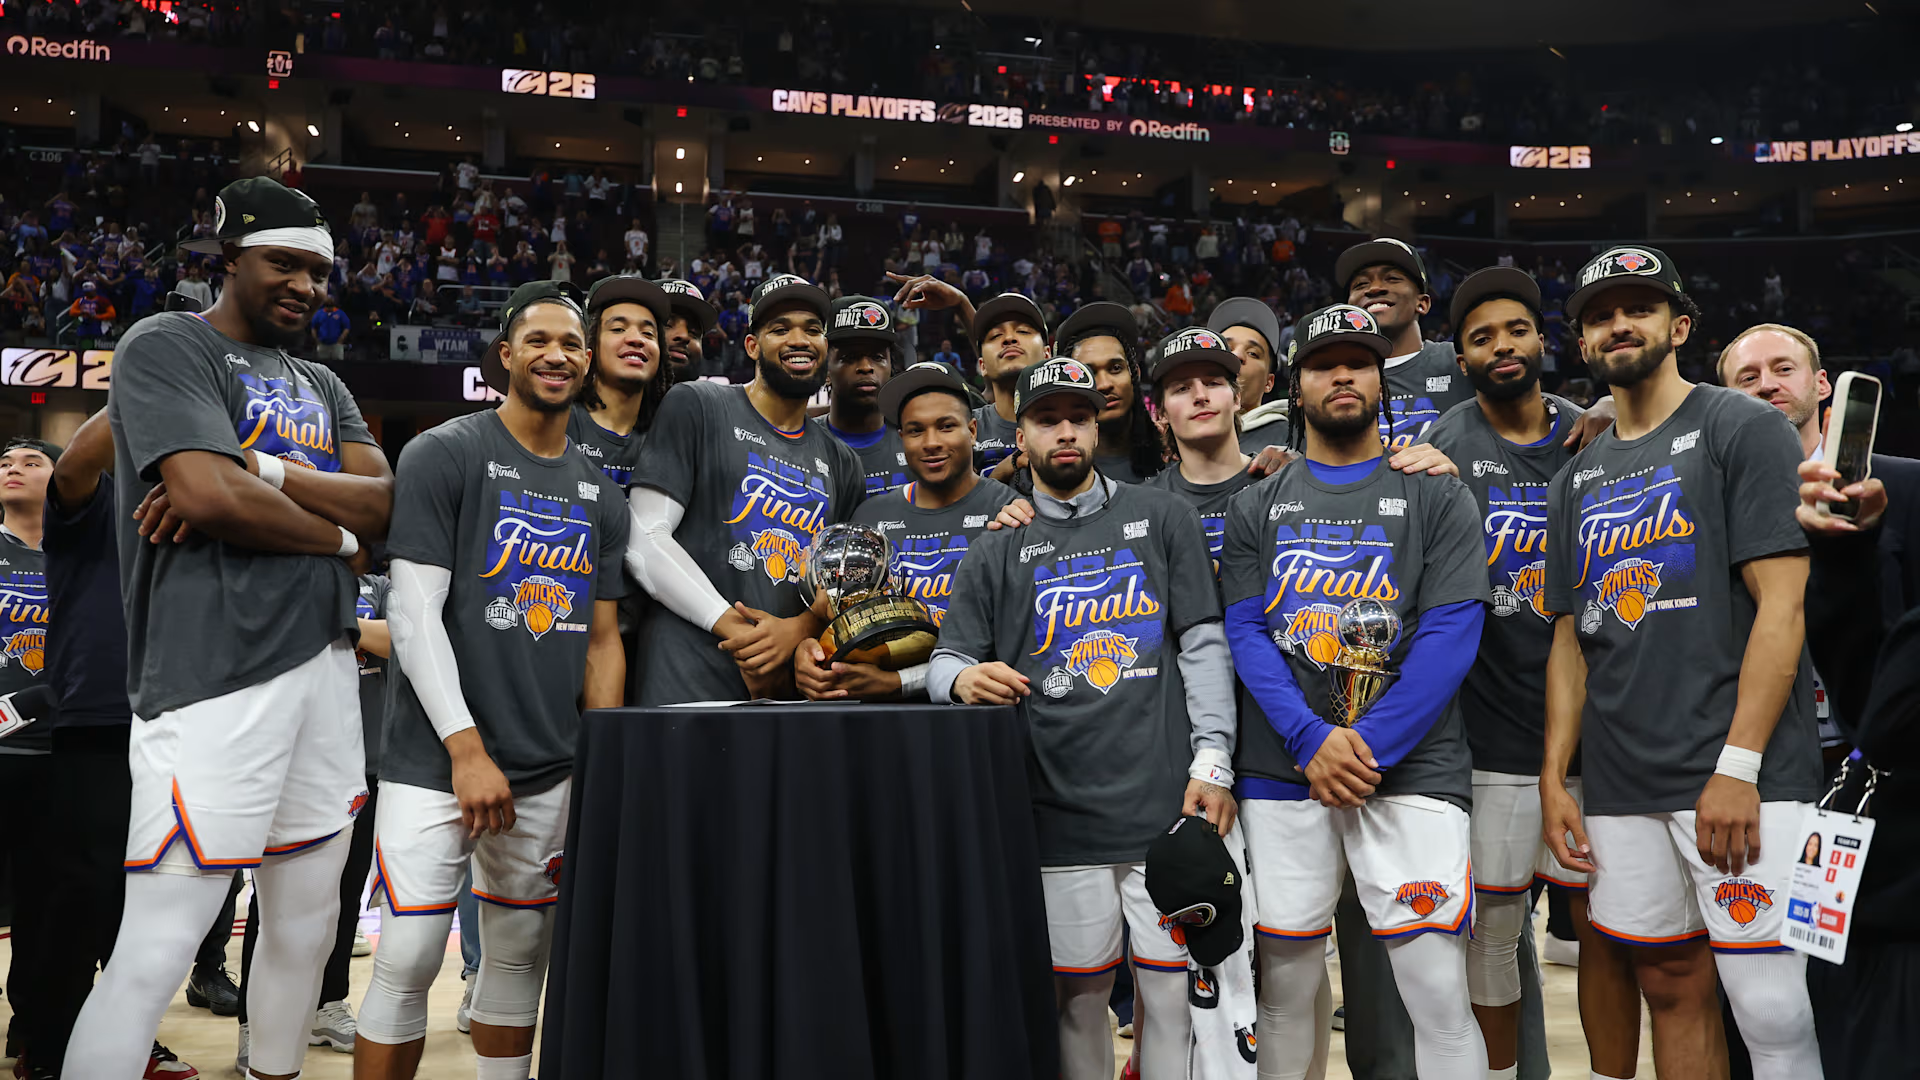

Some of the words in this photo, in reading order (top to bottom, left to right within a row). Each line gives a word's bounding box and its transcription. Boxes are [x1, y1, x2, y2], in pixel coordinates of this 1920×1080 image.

[31, 37, 110, 61] Redfin
[549, 72, 596, 99] 26
[772, 89, 827, 115] CAVS
[831, 93, 936, 123] PLAYOFFS
[968, 104, 1023, 129] 2026
[1029, 113, 1100, 131] PRESENTED
[1107, 118, 1122, 131] BY
[1148, 120, 1210, 142] Redfin
[1549, 146, 1591, 169] 26
[1811, 131, 1920, 161] PLAYOFFS
[1582, 260, 1613, 287] FINALS
[834, 312, 861, 329] FINALS
[1308, 315, 1341, 341] FINALS
[434, 338, 469, 353] WTAM
[1163, 339, 1192, 358] FINALS
[1029, 368, 1061, 391] FINALS
[240, 396, 334, 455] Finals
[739, 428, 766, 446] Finals
[493, 463, 521, 480] Finals
[722, 474, 827, 535] Finals
[478, 517, 593, 578] Finals
[754, 531, 800, 564] KNICKS
[1276, 538, 1304, 546] EASTERN
[1305, 538, 1351, 546] CONFERENCE
[1353, 540, 1394, 548] CHAMPIONS
[1484, 510, 1548, 567] Fin
[1573, 492, 1695, 589] Finals
[1024, 541, 1056, 564] Finals
[1106, 561, 1144, 571] CHAMPIONS
[1264, 549, 1400, 614] Finals
[1514, 568, 1545, 592] KNI
[1601, 563, 1659, 602] KNICKS
[516, 581, 571, 611] KNICKS
[1494, 594, 1517, 609] STERN
[1656, 599, 1674, 611] YORK
[1674, 596, 1698, 609] KNICKS
[486, 606, 517, 622] EASTERN
[871, 609, 906, 623] CONFERENCE
[1029, 574, 1159, 656] Finals
[1288, 610, 1338, 636] KNIC
[1069, 635, 1136, 669] KNICKS
[1045, 677, 1072, 691] EASTERN
[1123, 670, 1135, 680] NEW
[1396, 881, 1449, 901] KNICKS
[1715, 882, 1773, 906] KNICKS
